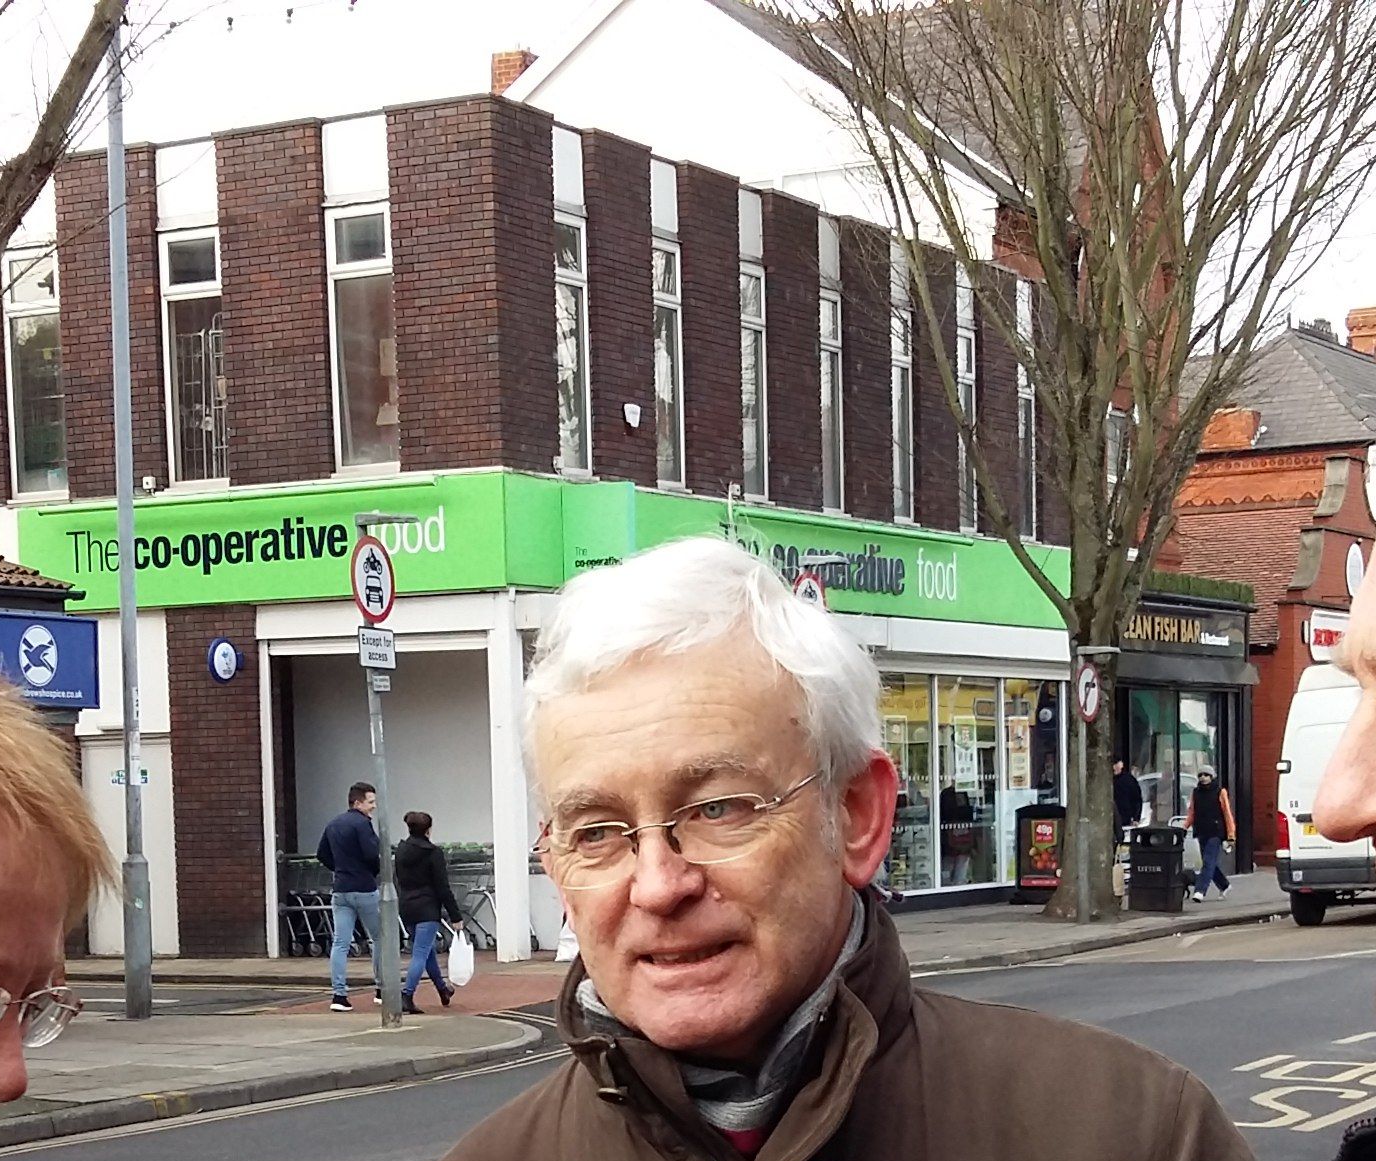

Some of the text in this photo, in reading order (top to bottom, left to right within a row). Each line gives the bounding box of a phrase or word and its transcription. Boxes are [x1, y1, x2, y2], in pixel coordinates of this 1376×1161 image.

[66, 530, 120, 574] The
[134, 516, 348, 575] co-operative
[916, 547, 957, 601] food
[361, 633, 392, 648] Except for
[1124, 614, 1152, 640] EAN
[1153, 616, 1178, 642] FISH
[1180, 618, 1202, 644] BAR
[368, 651, 388, 662] access
